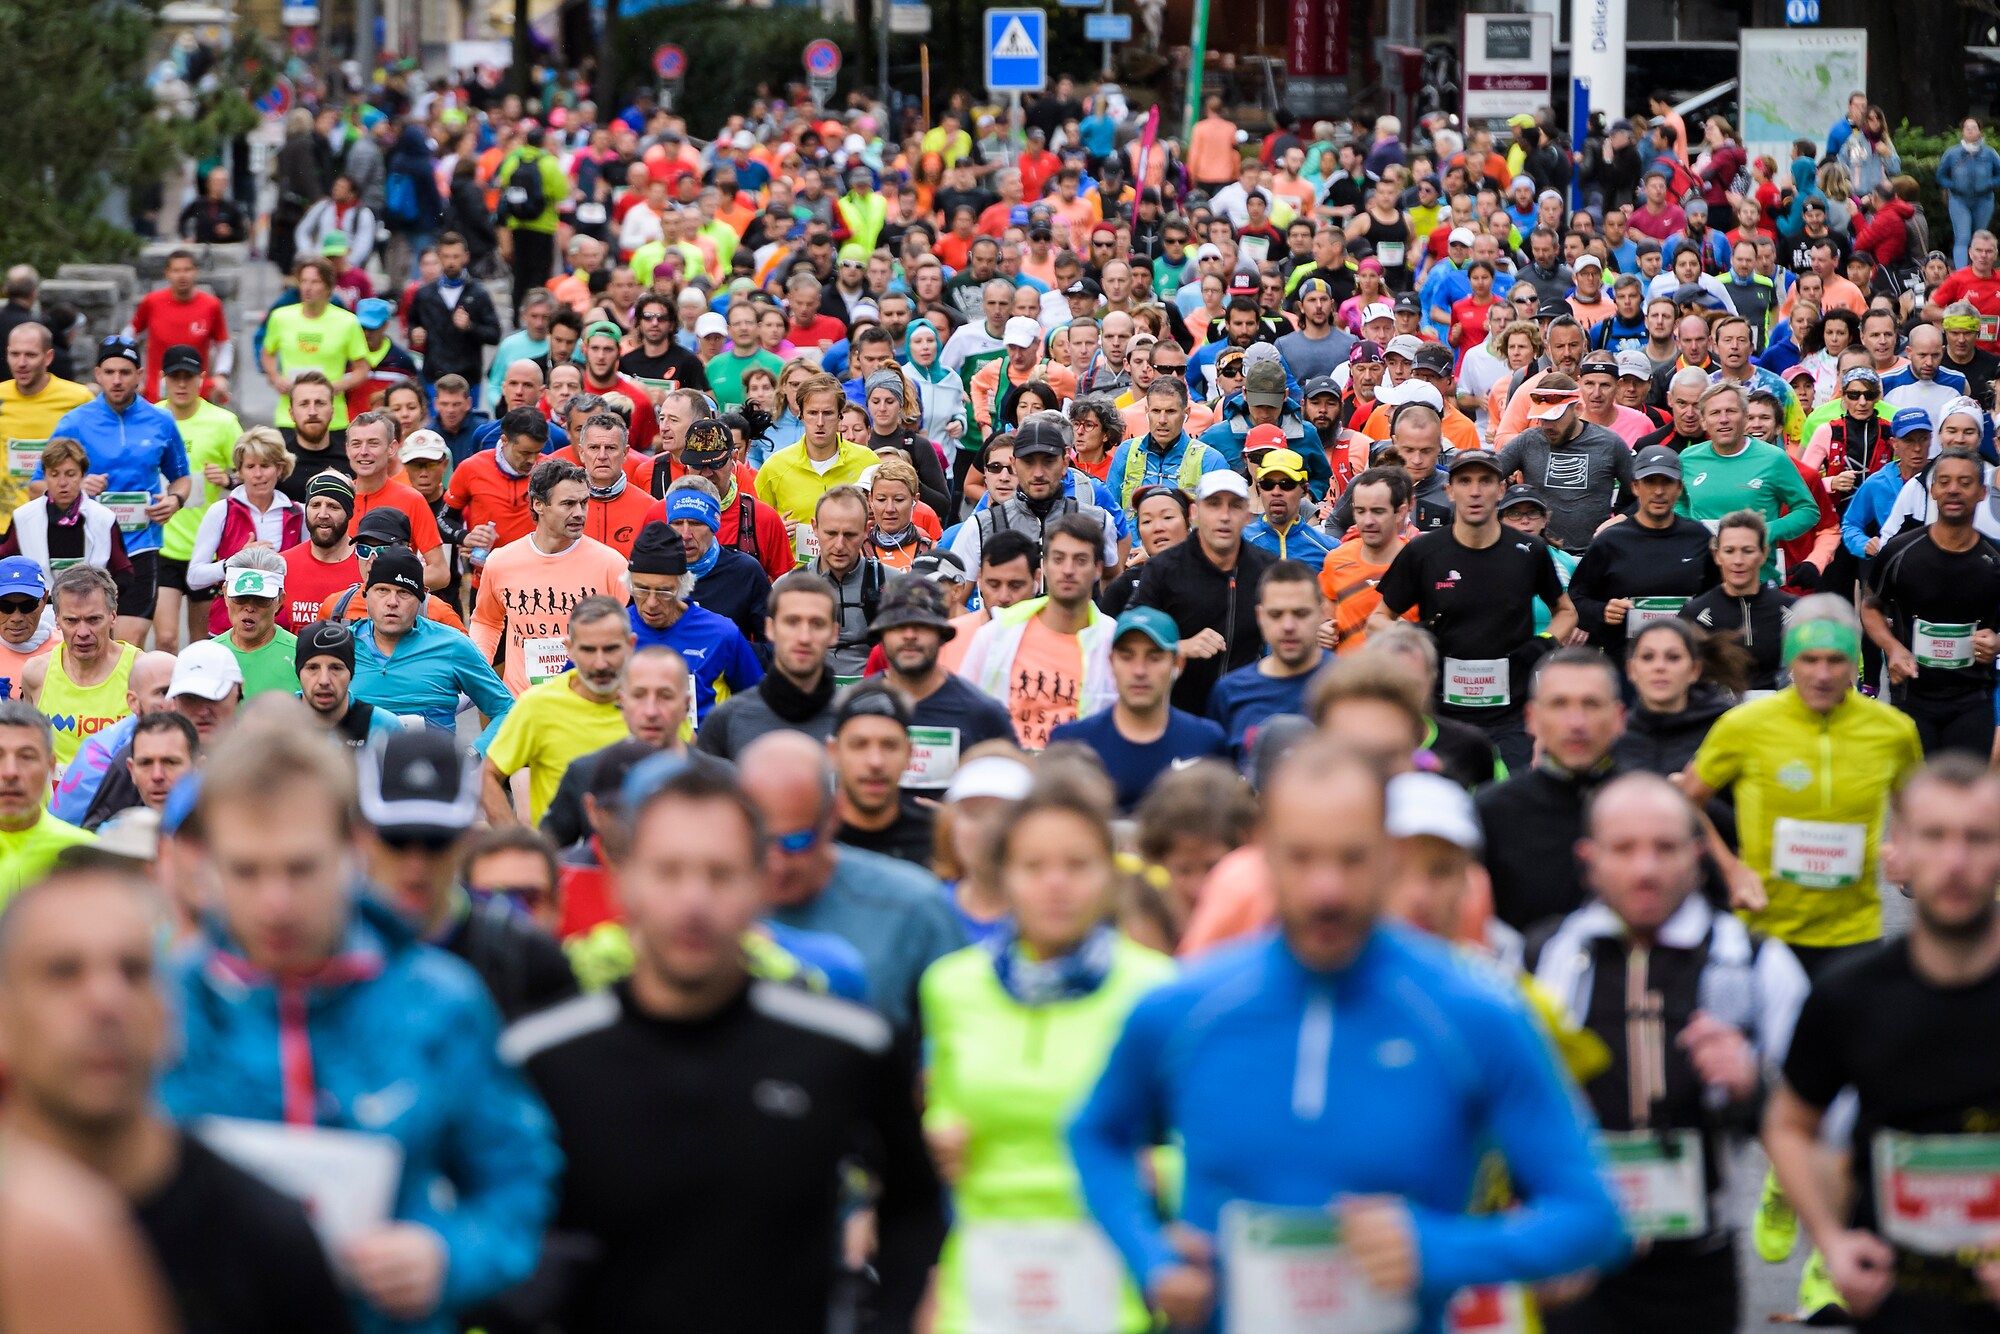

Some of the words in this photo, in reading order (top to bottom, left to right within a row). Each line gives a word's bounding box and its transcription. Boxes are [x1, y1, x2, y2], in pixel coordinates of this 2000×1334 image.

[1435, 581, 1456, 590] pwc
[538, 655, 570, 664] MARKUS
[1452, 675, 1496, 685] GUILLAUME
